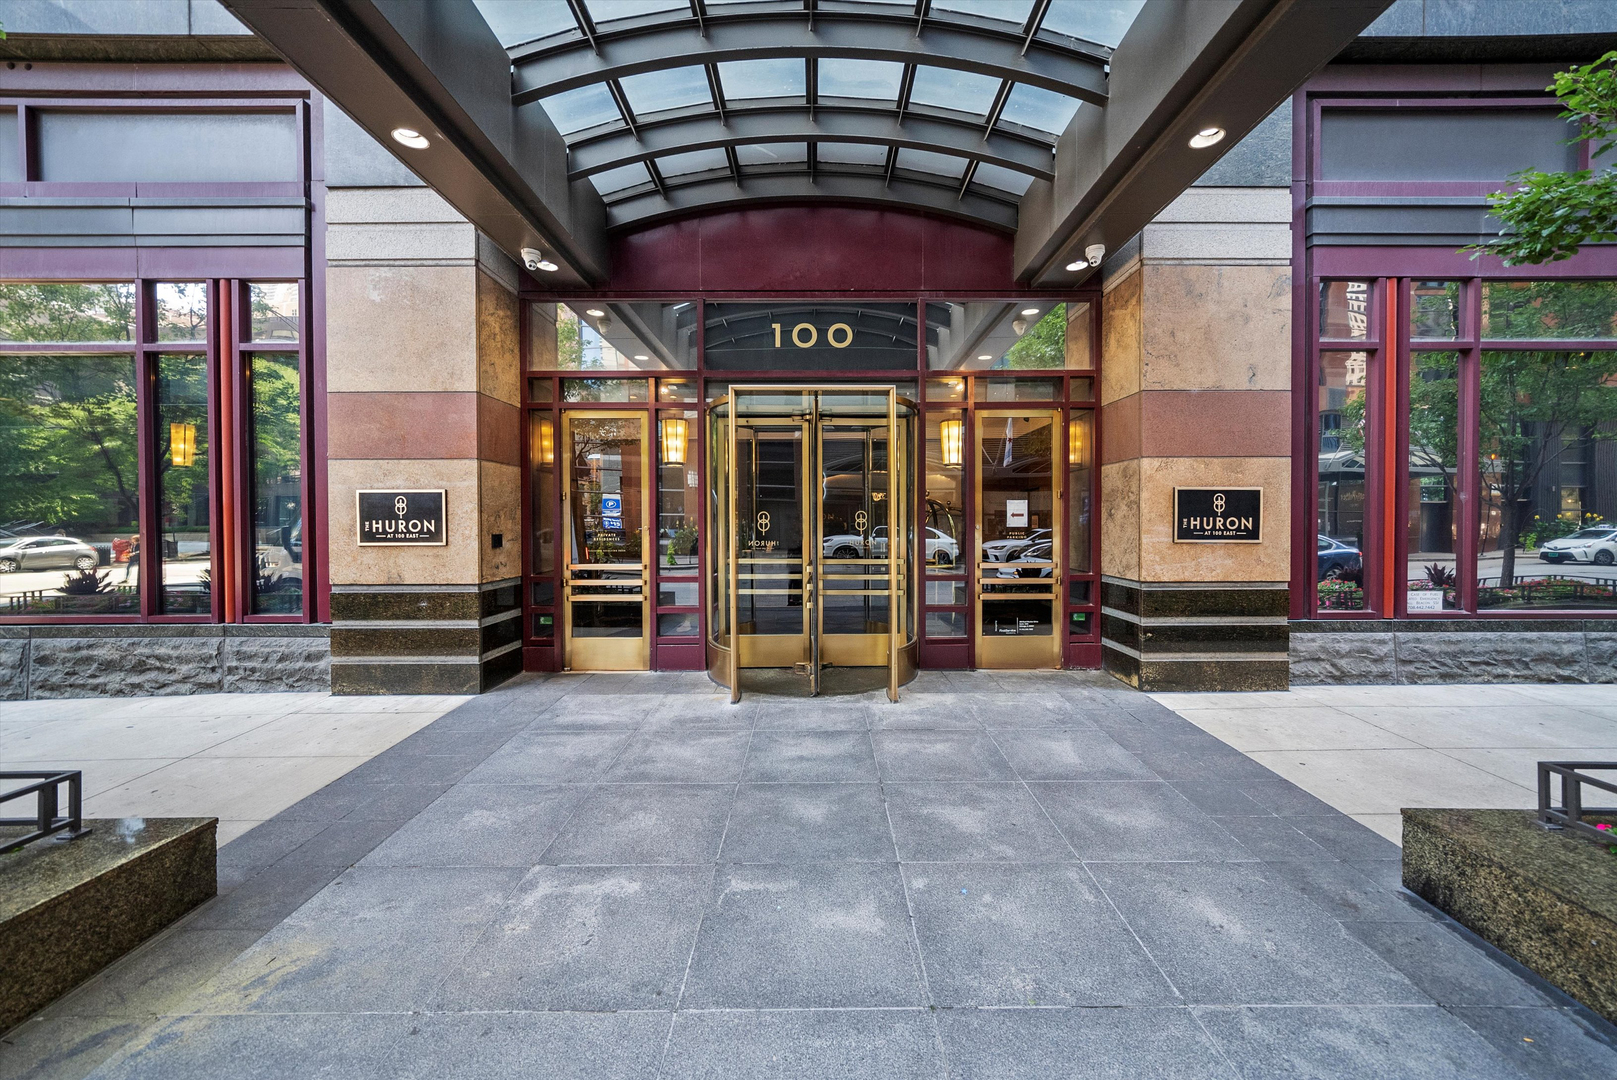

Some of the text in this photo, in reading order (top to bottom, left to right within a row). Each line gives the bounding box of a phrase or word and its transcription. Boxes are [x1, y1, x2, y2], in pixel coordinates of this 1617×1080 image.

[771, 322, 854, 349] 100
[372, 519, 435, 533] HURON
[1190, 516, 1253, 530] HURON
